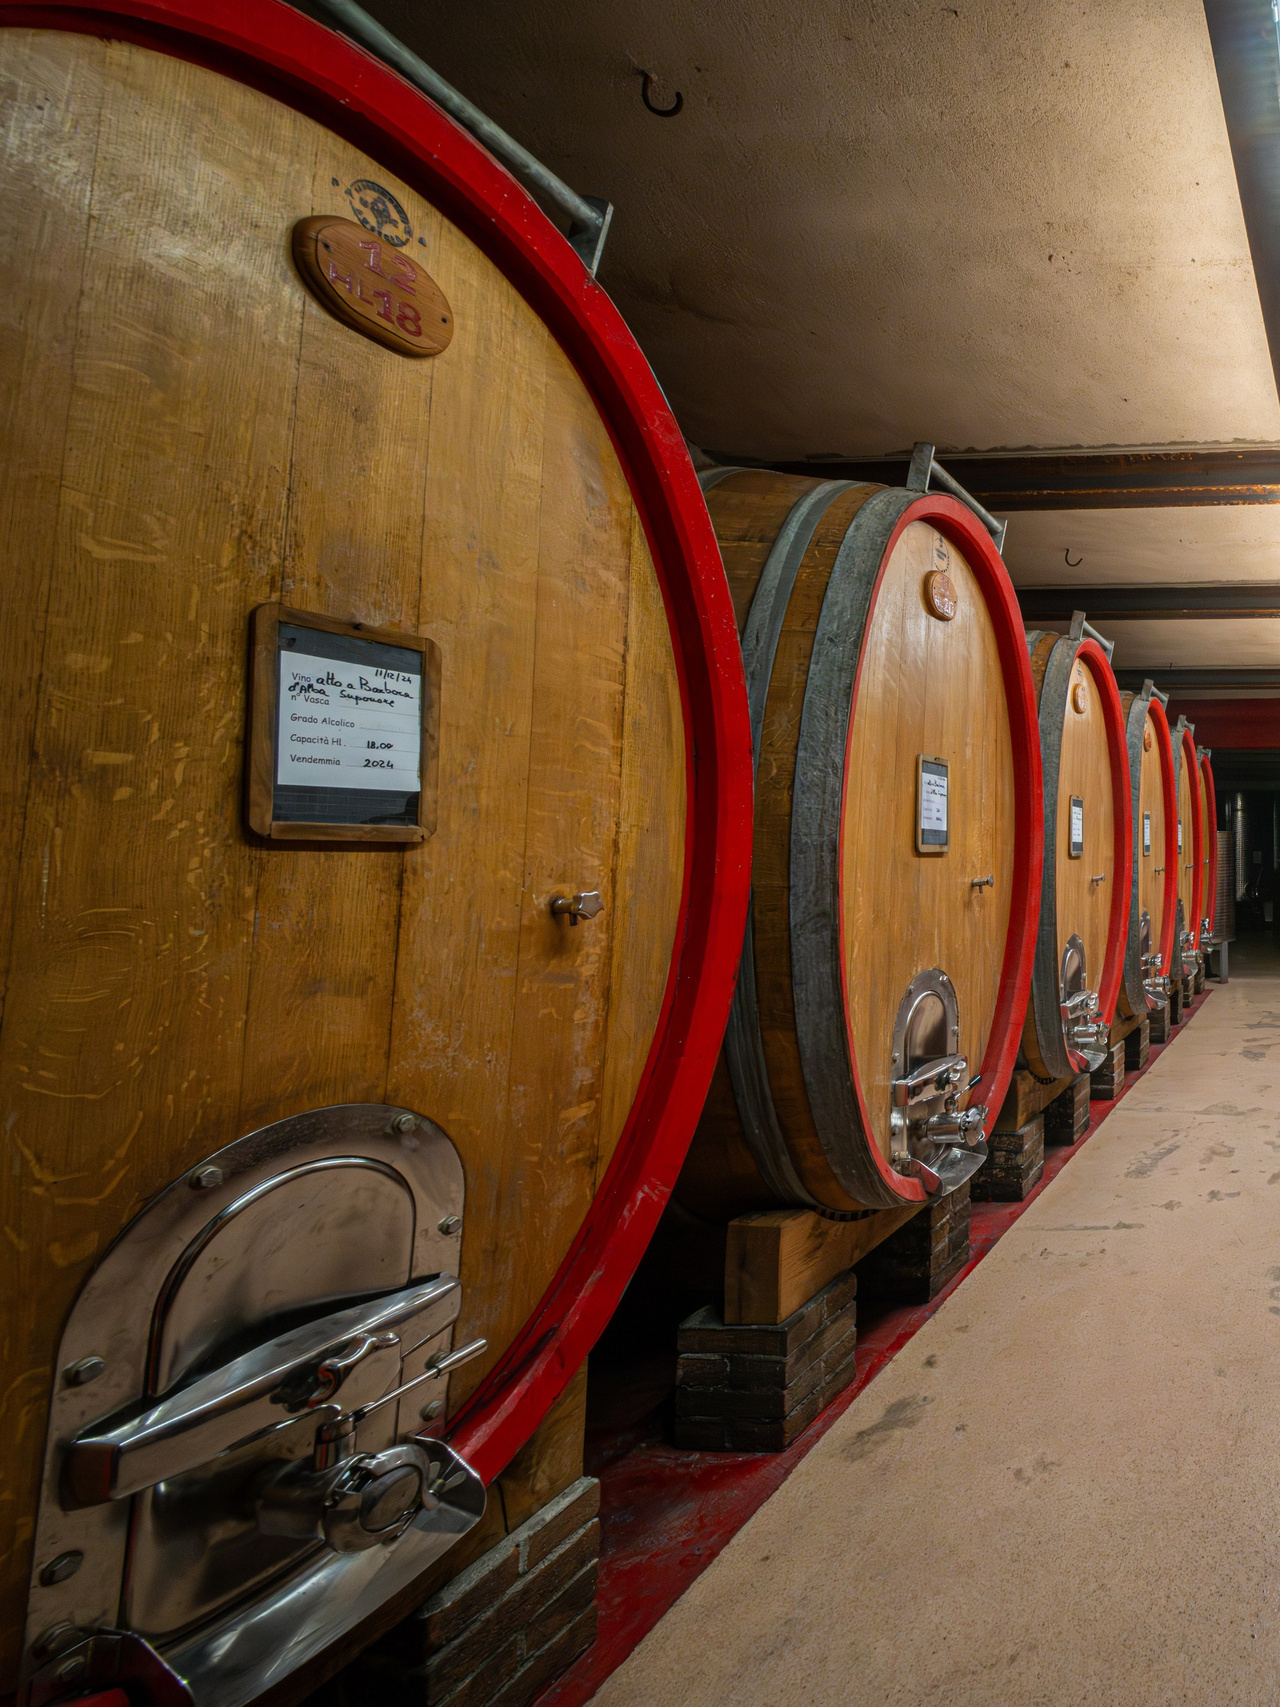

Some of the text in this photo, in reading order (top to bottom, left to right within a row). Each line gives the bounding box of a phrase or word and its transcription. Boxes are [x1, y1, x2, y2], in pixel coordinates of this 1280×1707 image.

[360, 241, 417, 296] 12
[373, 289, 422, 337] 18
[292, 672, 311, 683] Vino
[375, 669, 412, 685] 11/12/24
[304, 694, 330, 706] Vasca
[290, 713, 355, 728] Grado Alcolico
[290, 733, 329, 746] Capacità
[290, 754, 394, 769] Vendemmia 2024
